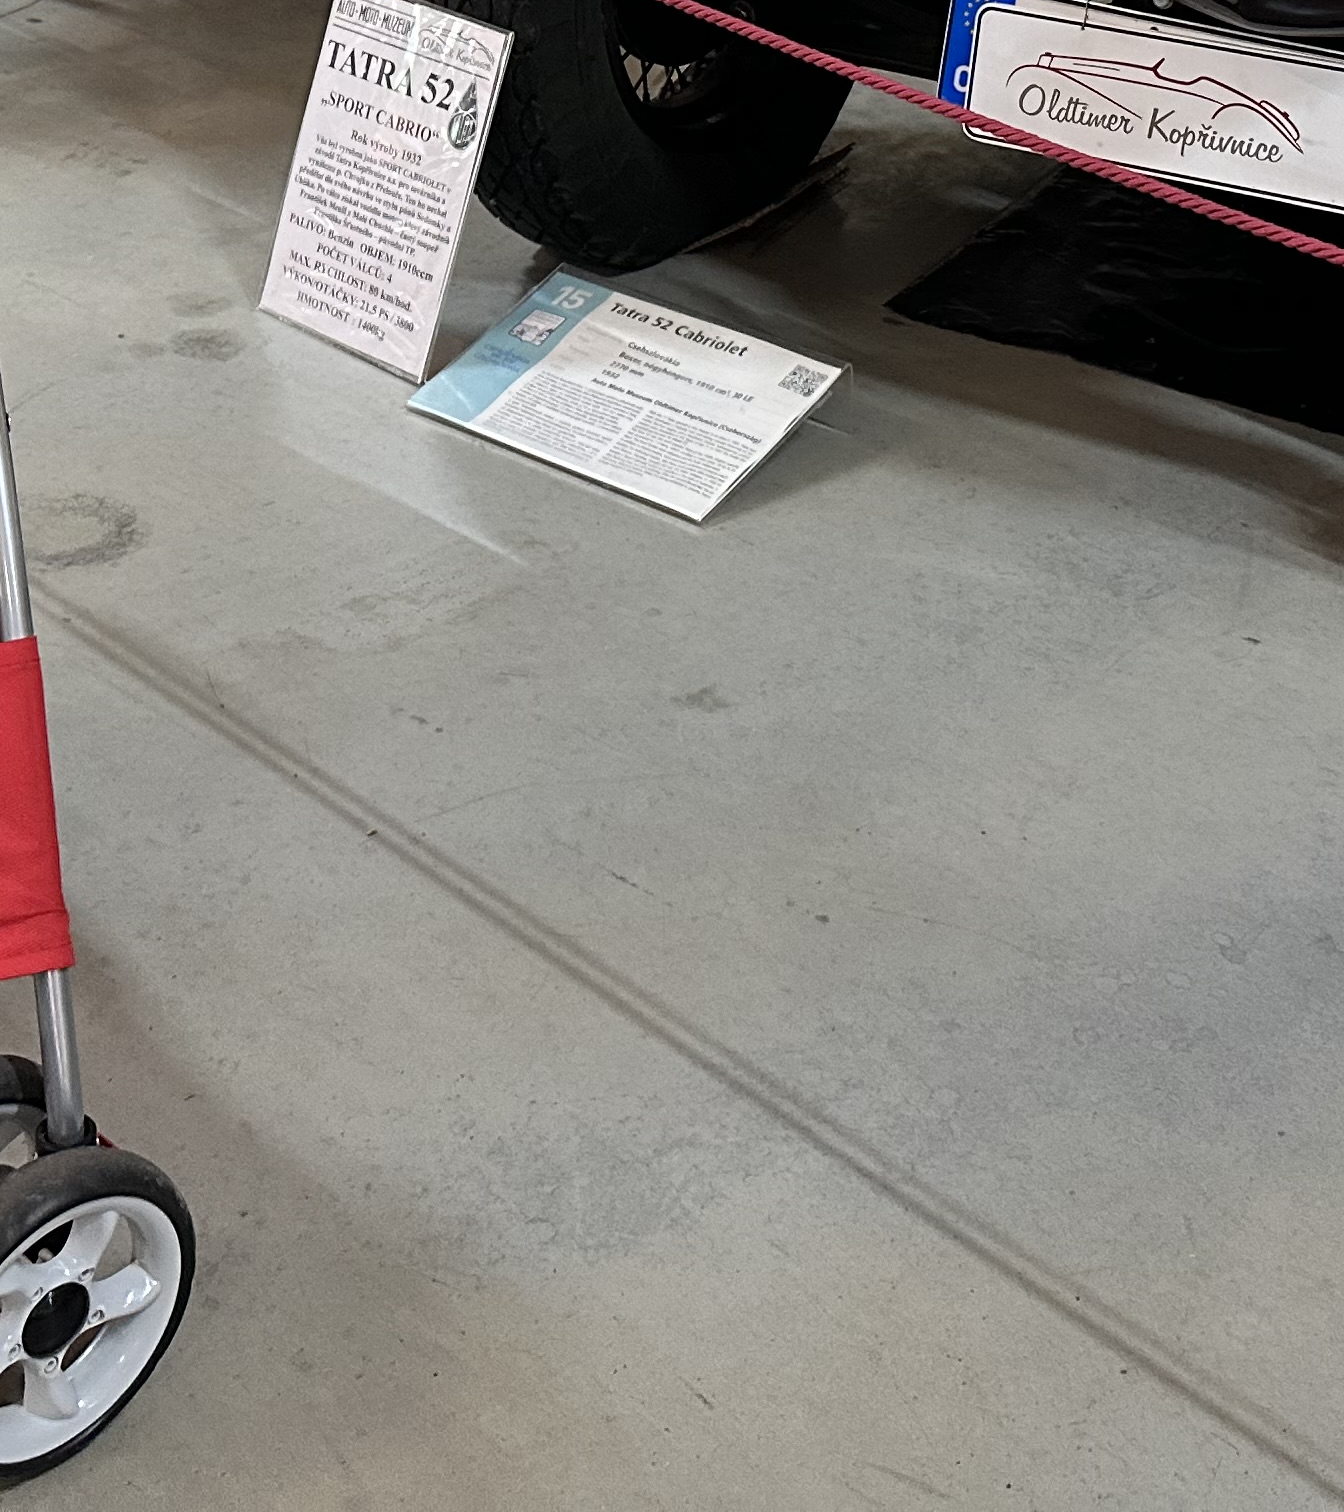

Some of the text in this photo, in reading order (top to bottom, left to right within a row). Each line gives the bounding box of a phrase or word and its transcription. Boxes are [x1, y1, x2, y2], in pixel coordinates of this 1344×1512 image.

[329, 40, 455, 111] TATRA 52
[1019, 84, 1283, 163] Oldtimer Kopřivnice
[350, 129, 422, 167] Rok výroby 1932
[402, 168, 446, 192] CABRIOLET
[316, 239, 348, 264] POČET
[551, 286, 593, 309] 15
[608, 302, 752, 357] Tatra 52 Cabriolet
